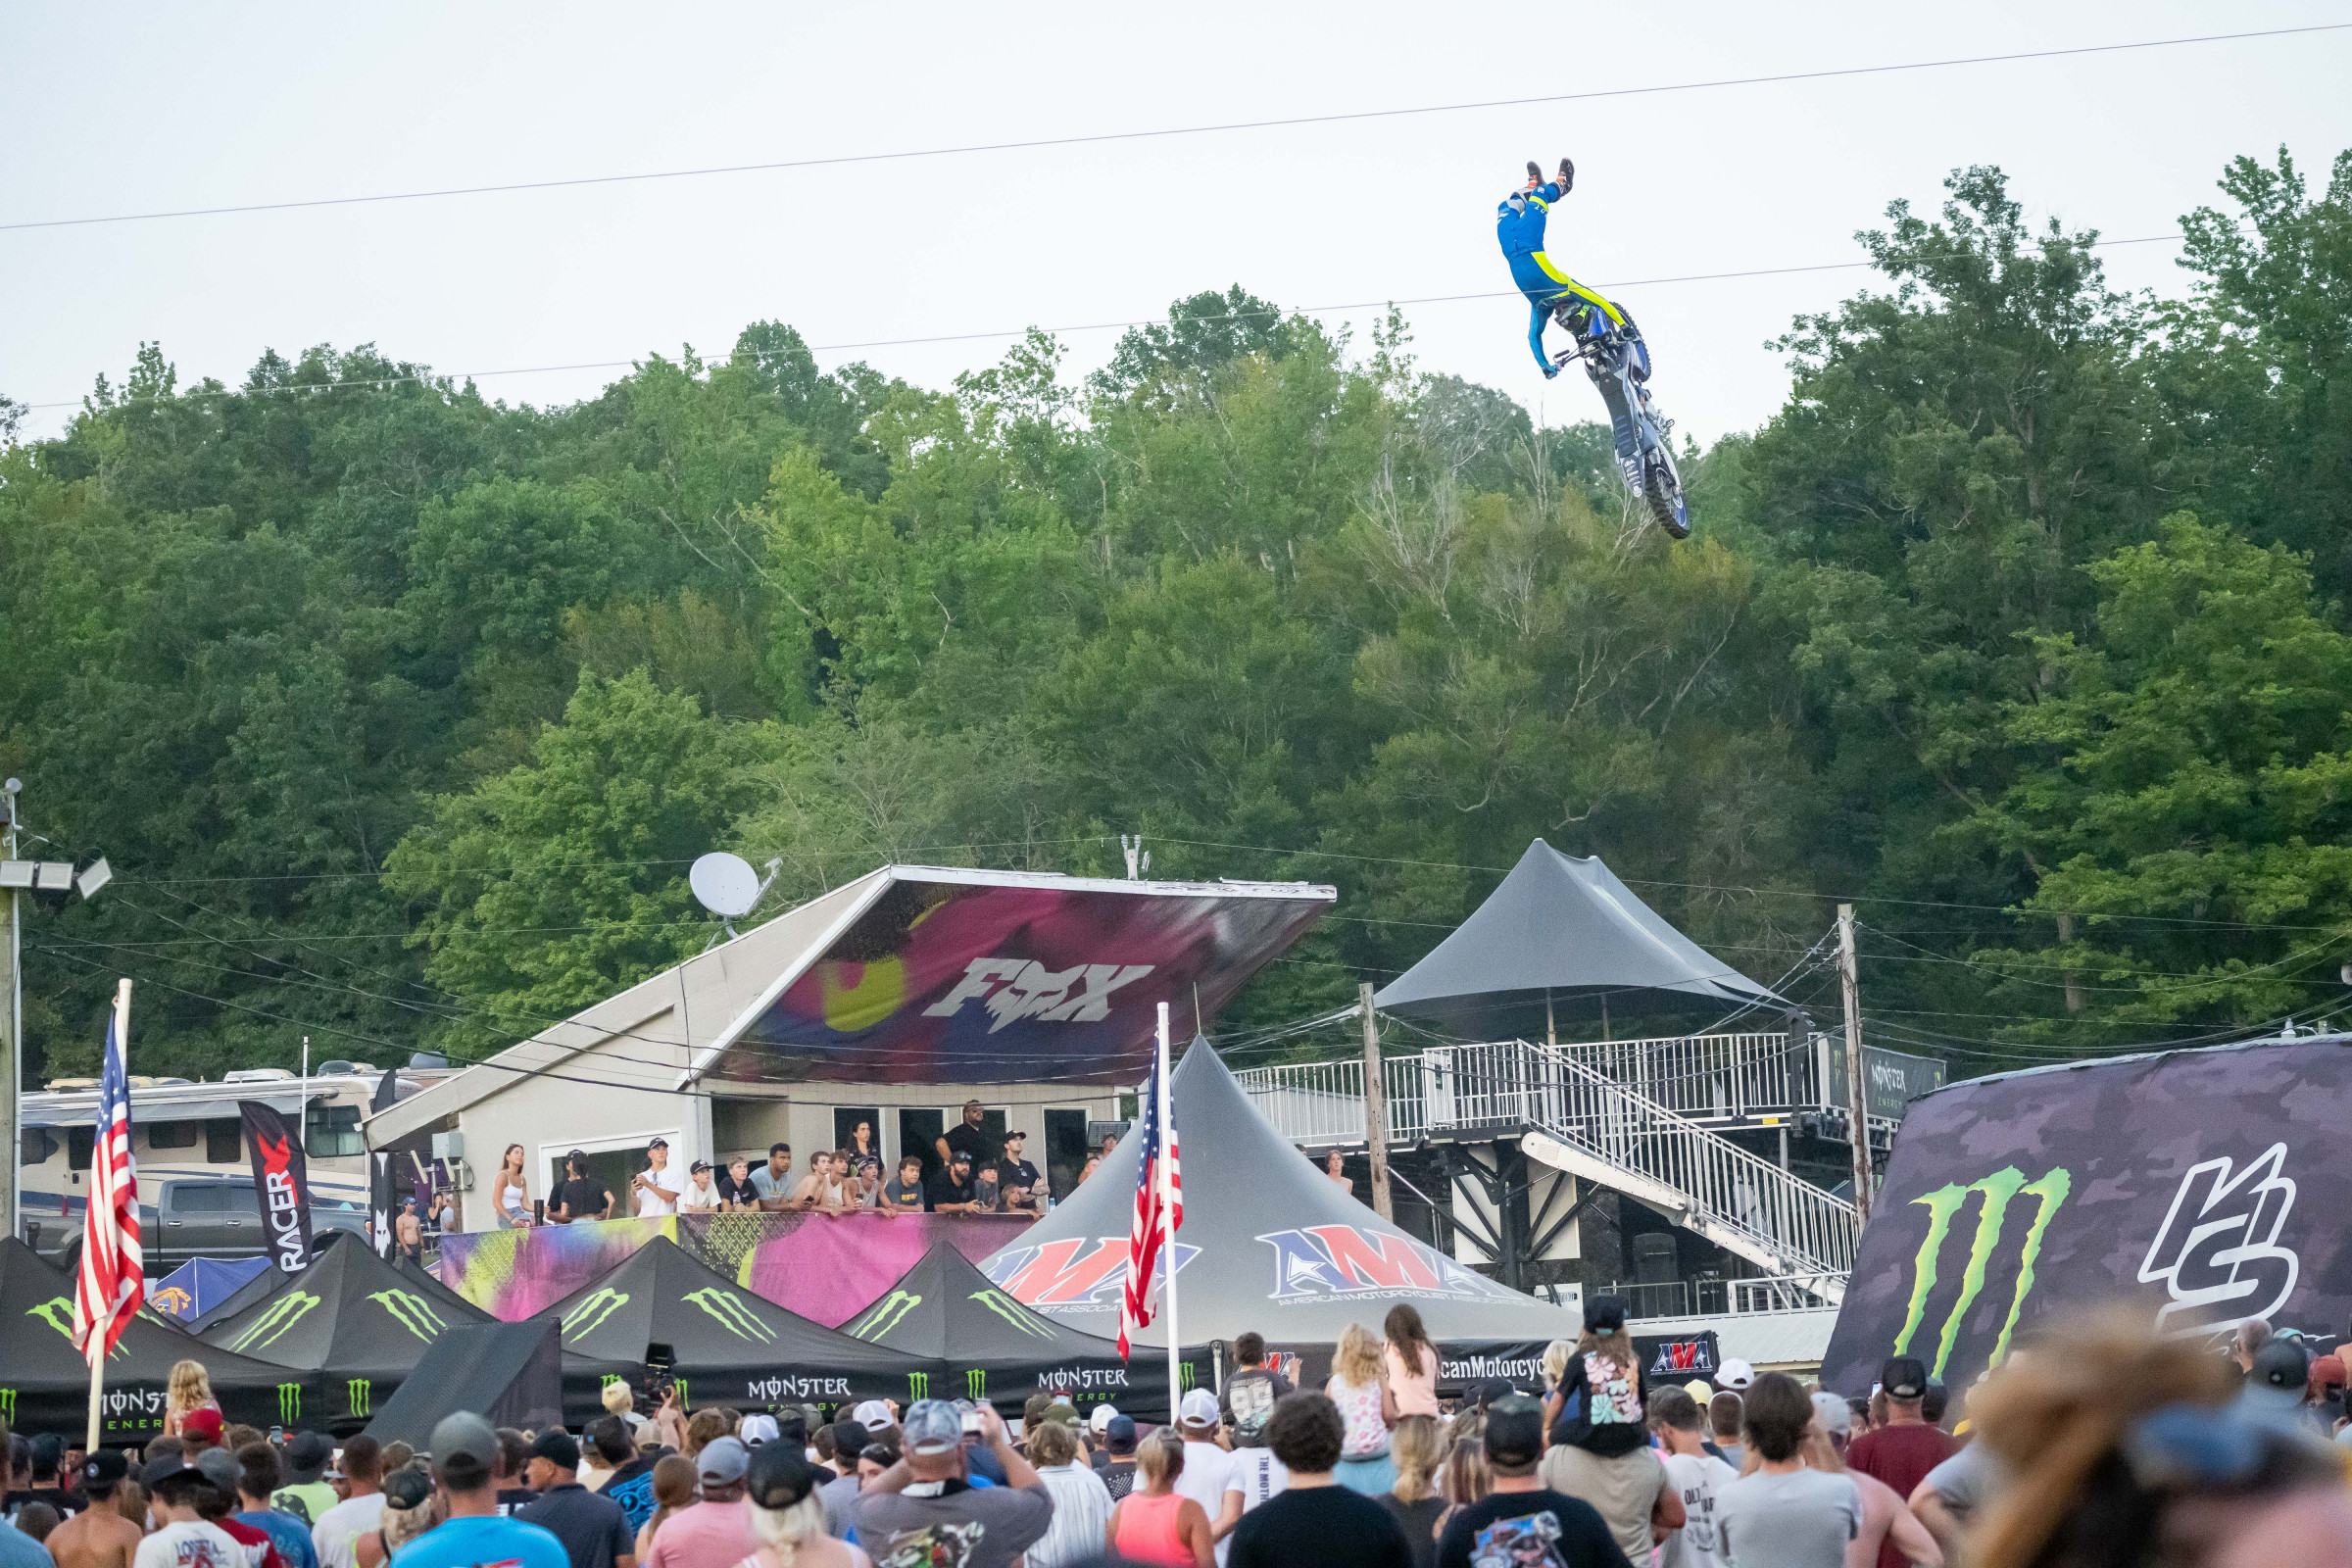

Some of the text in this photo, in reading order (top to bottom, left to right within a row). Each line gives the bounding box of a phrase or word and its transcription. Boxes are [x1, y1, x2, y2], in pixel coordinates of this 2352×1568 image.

[920, 956, 1155, 1035] FOX
[1871, 1059, 1907, 1093] MONSTER
[1878, 1097, 1901, 1109] ENERGY
[1253, 1224, 1527, 1299] AMA
[1278, 1293, 1349, 1306] AMERICAN
[1650, 1341, 1713, 1372] AMA
[748, 1374, 853, 1401] MONSTER
[1039, 1366, 1130, 1391] MONSTER
[107, 1419, 163, 1430] ENER
[1258, 1455, 1270, 1503] THE MOTH
